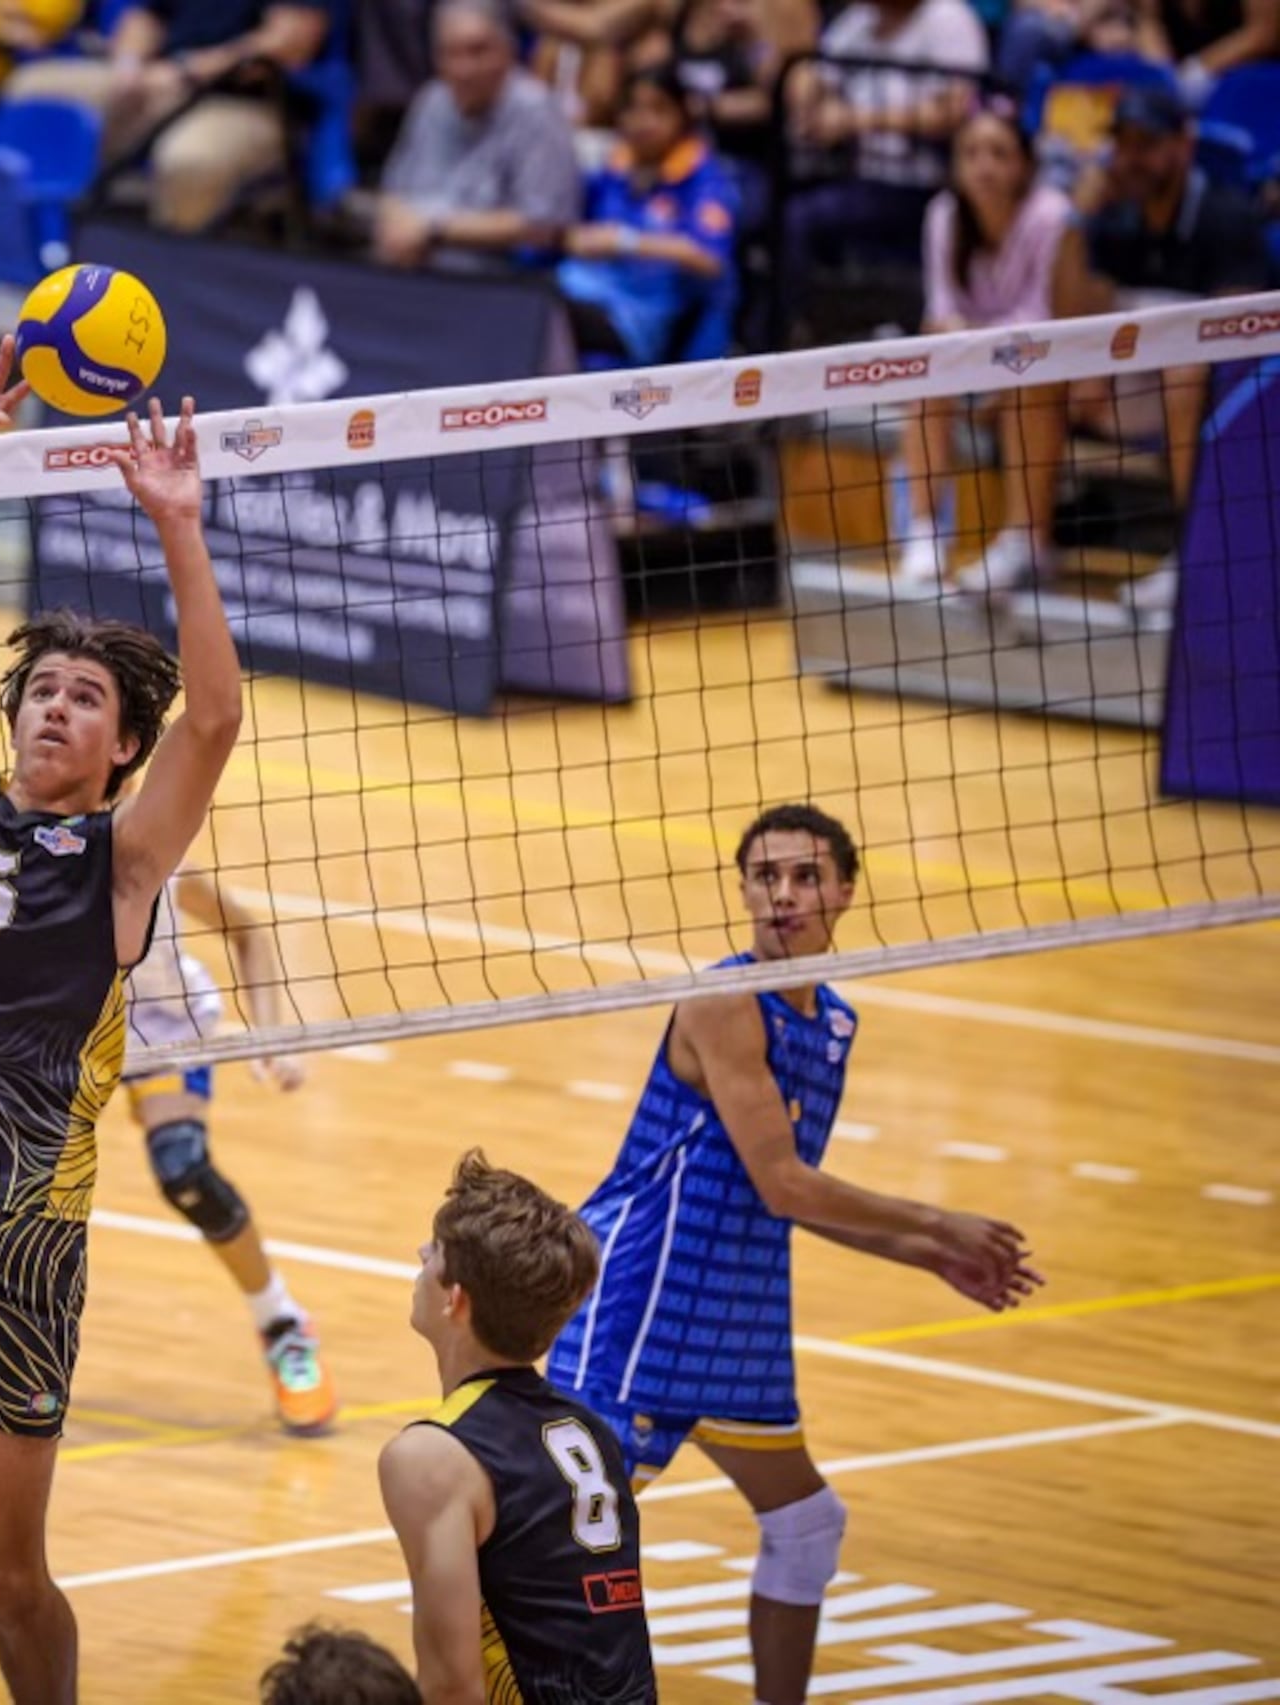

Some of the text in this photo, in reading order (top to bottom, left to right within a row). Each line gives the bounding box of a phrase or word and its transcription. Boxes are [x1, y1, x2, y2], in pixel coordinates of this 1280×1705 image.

[829, 360, 925, 384] ECONO
[444, 403, 543, 426] ECONO
[541, 1416, 622, 1554] 8
